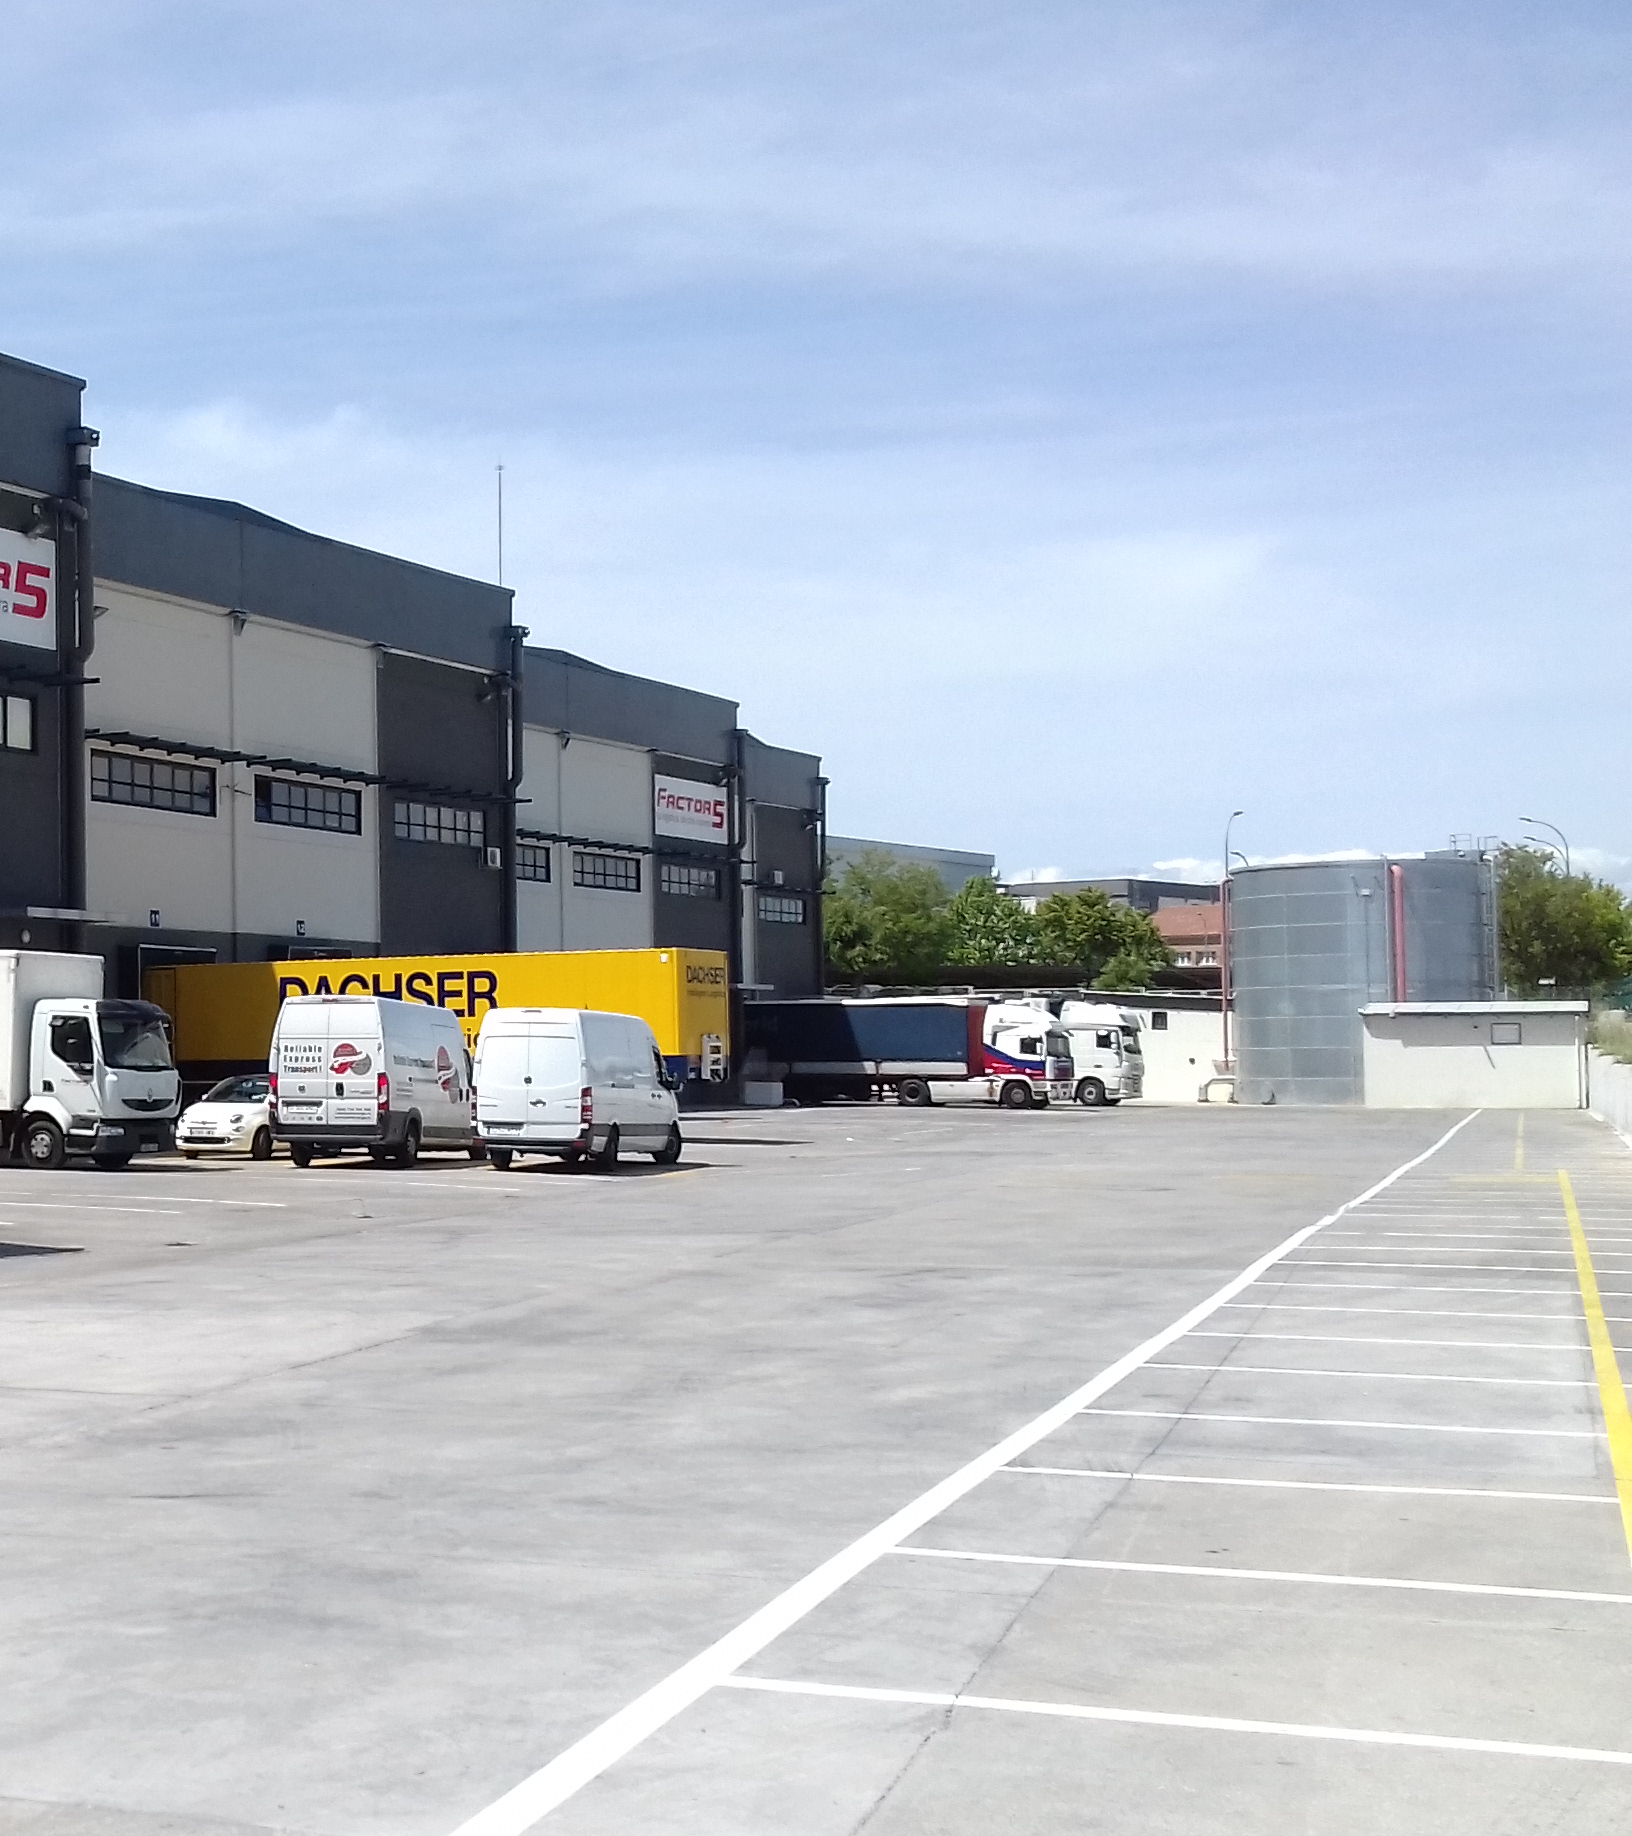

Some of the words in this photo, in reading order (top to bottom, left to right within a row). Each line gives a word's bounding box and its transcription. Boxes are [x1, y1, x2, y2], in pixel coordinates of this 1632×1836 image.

[657, 788, 725, 829] FACTOR5
[284, 1044, 323, 1053] Reliable
[283, 1054, 322, 1063] Express
